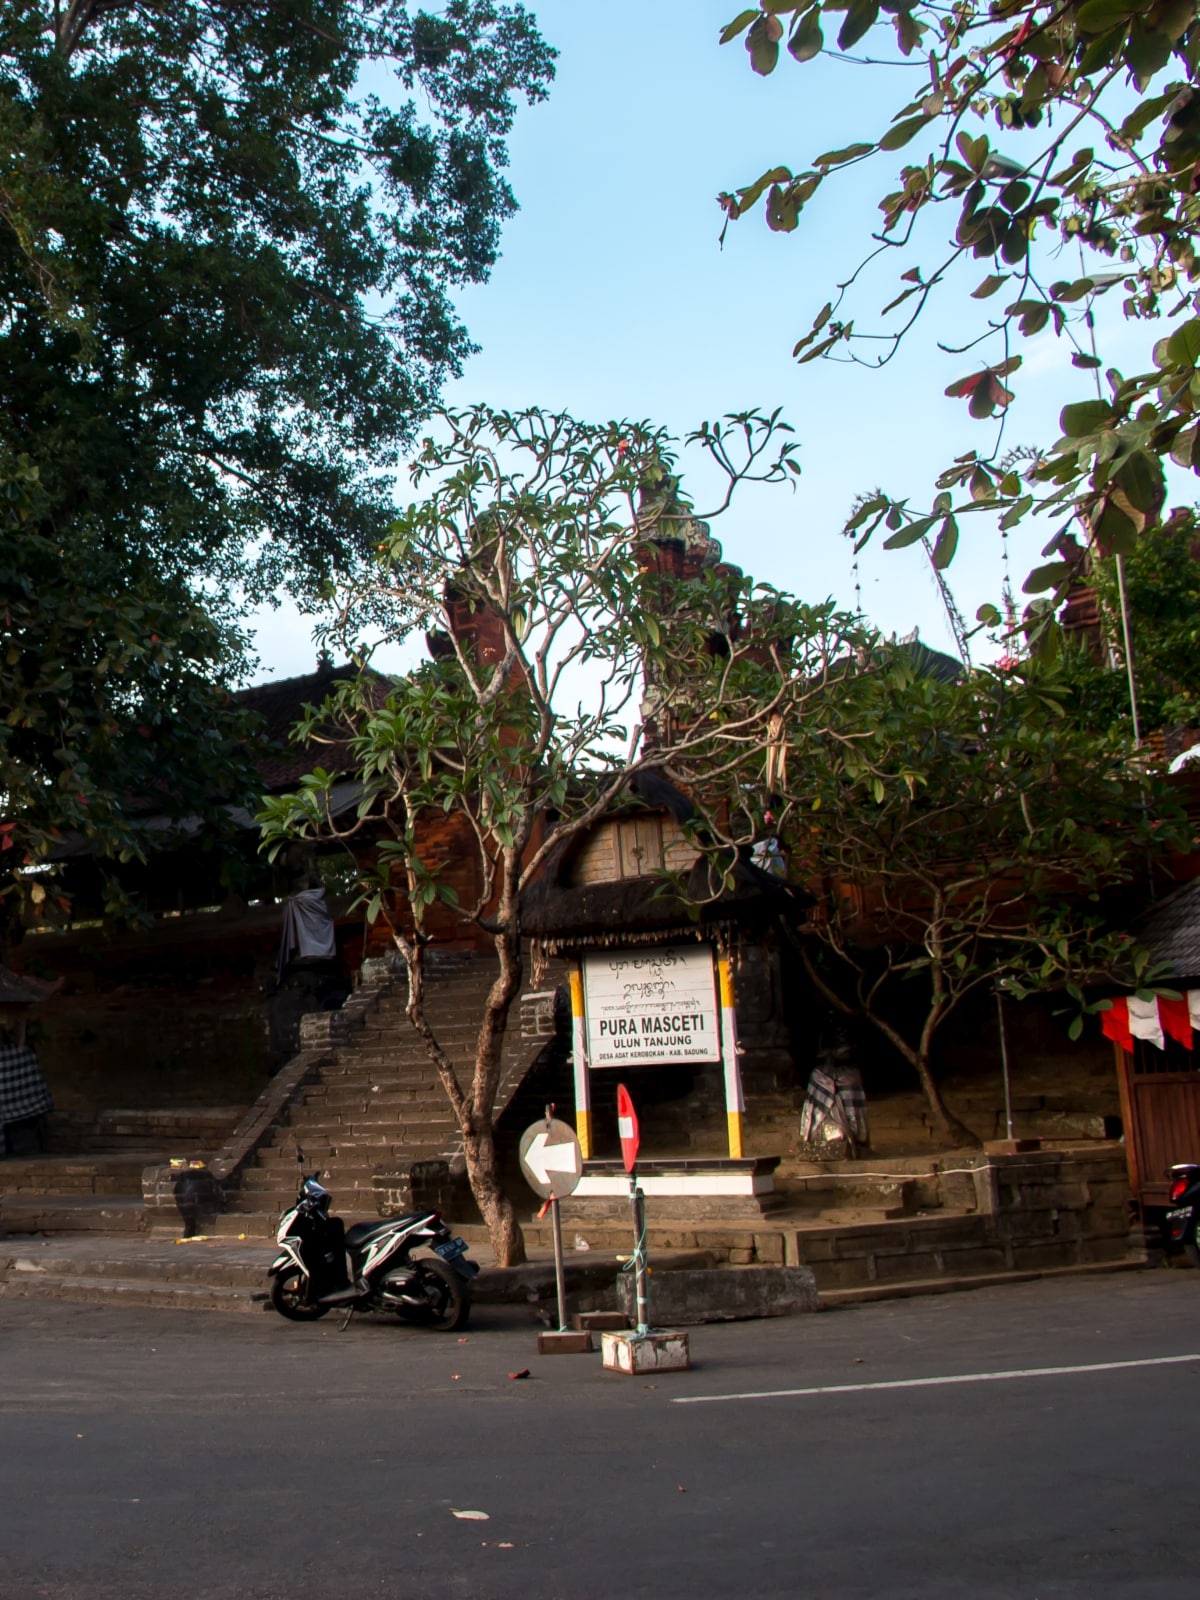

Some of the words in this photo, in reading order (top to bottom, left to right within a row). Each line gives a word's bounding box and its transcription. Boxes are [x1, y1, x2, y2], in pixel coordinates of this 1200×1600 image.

[600, 1018, 637, 1036] PURA
[641, 1014, 704, 1034] MASCETI
[613, 1038, 641, 1049] ULUN
[644, 1035, 692, 1047] TANJUNG
[630, 1050, 665, 1058] KEROBOKAN
